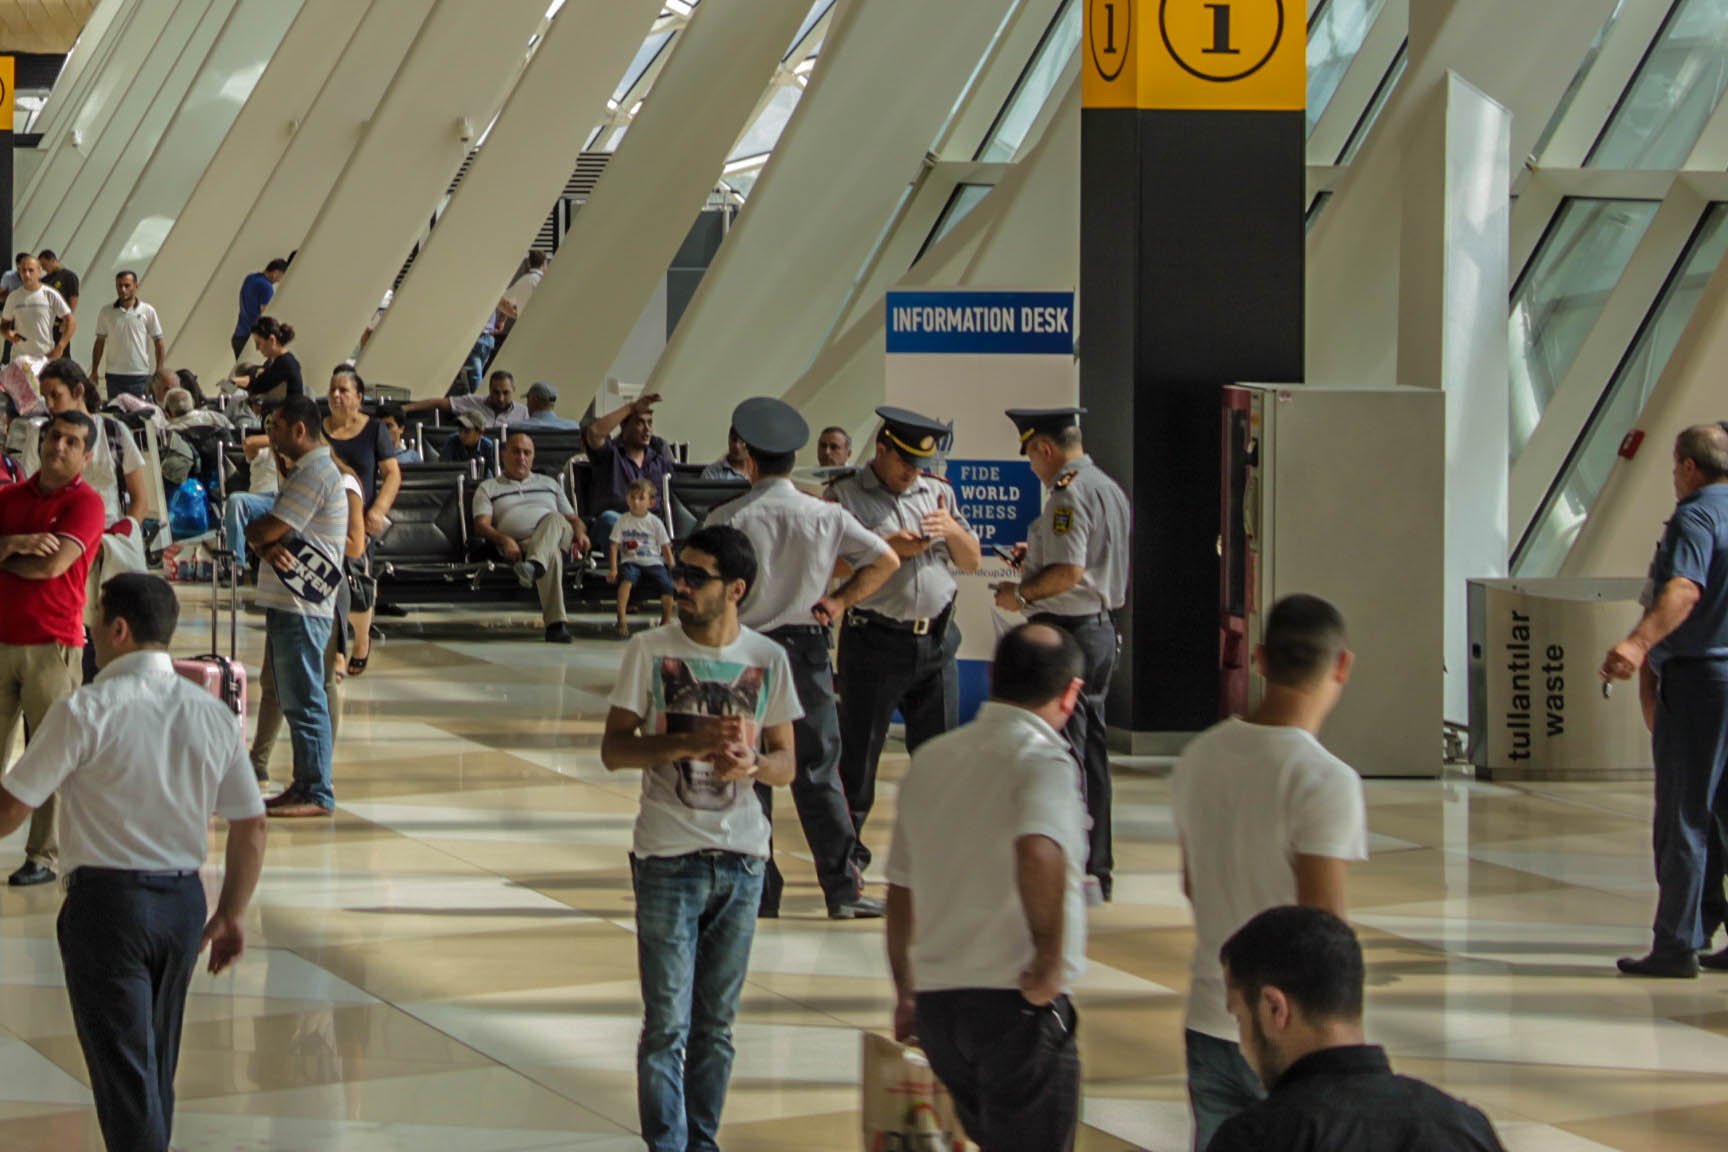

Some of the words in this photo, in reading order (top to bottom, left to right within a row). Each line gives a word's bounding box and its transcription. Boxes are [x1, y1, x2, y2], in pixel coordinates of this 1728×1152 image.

[892, 307, 1015, 333] INFORMATION
[1021, 307, 1070, 333] DESK
[960, 466, 1000, 481] FIDE
[960, 485, 1020, 501] WORLD
[960, 504, 1017, 520] CHESS
[972, 524, 996, 539] UP
[1506, 610, 1531, 761] tullantılar
[1542, 644, 1565, 737] waste
